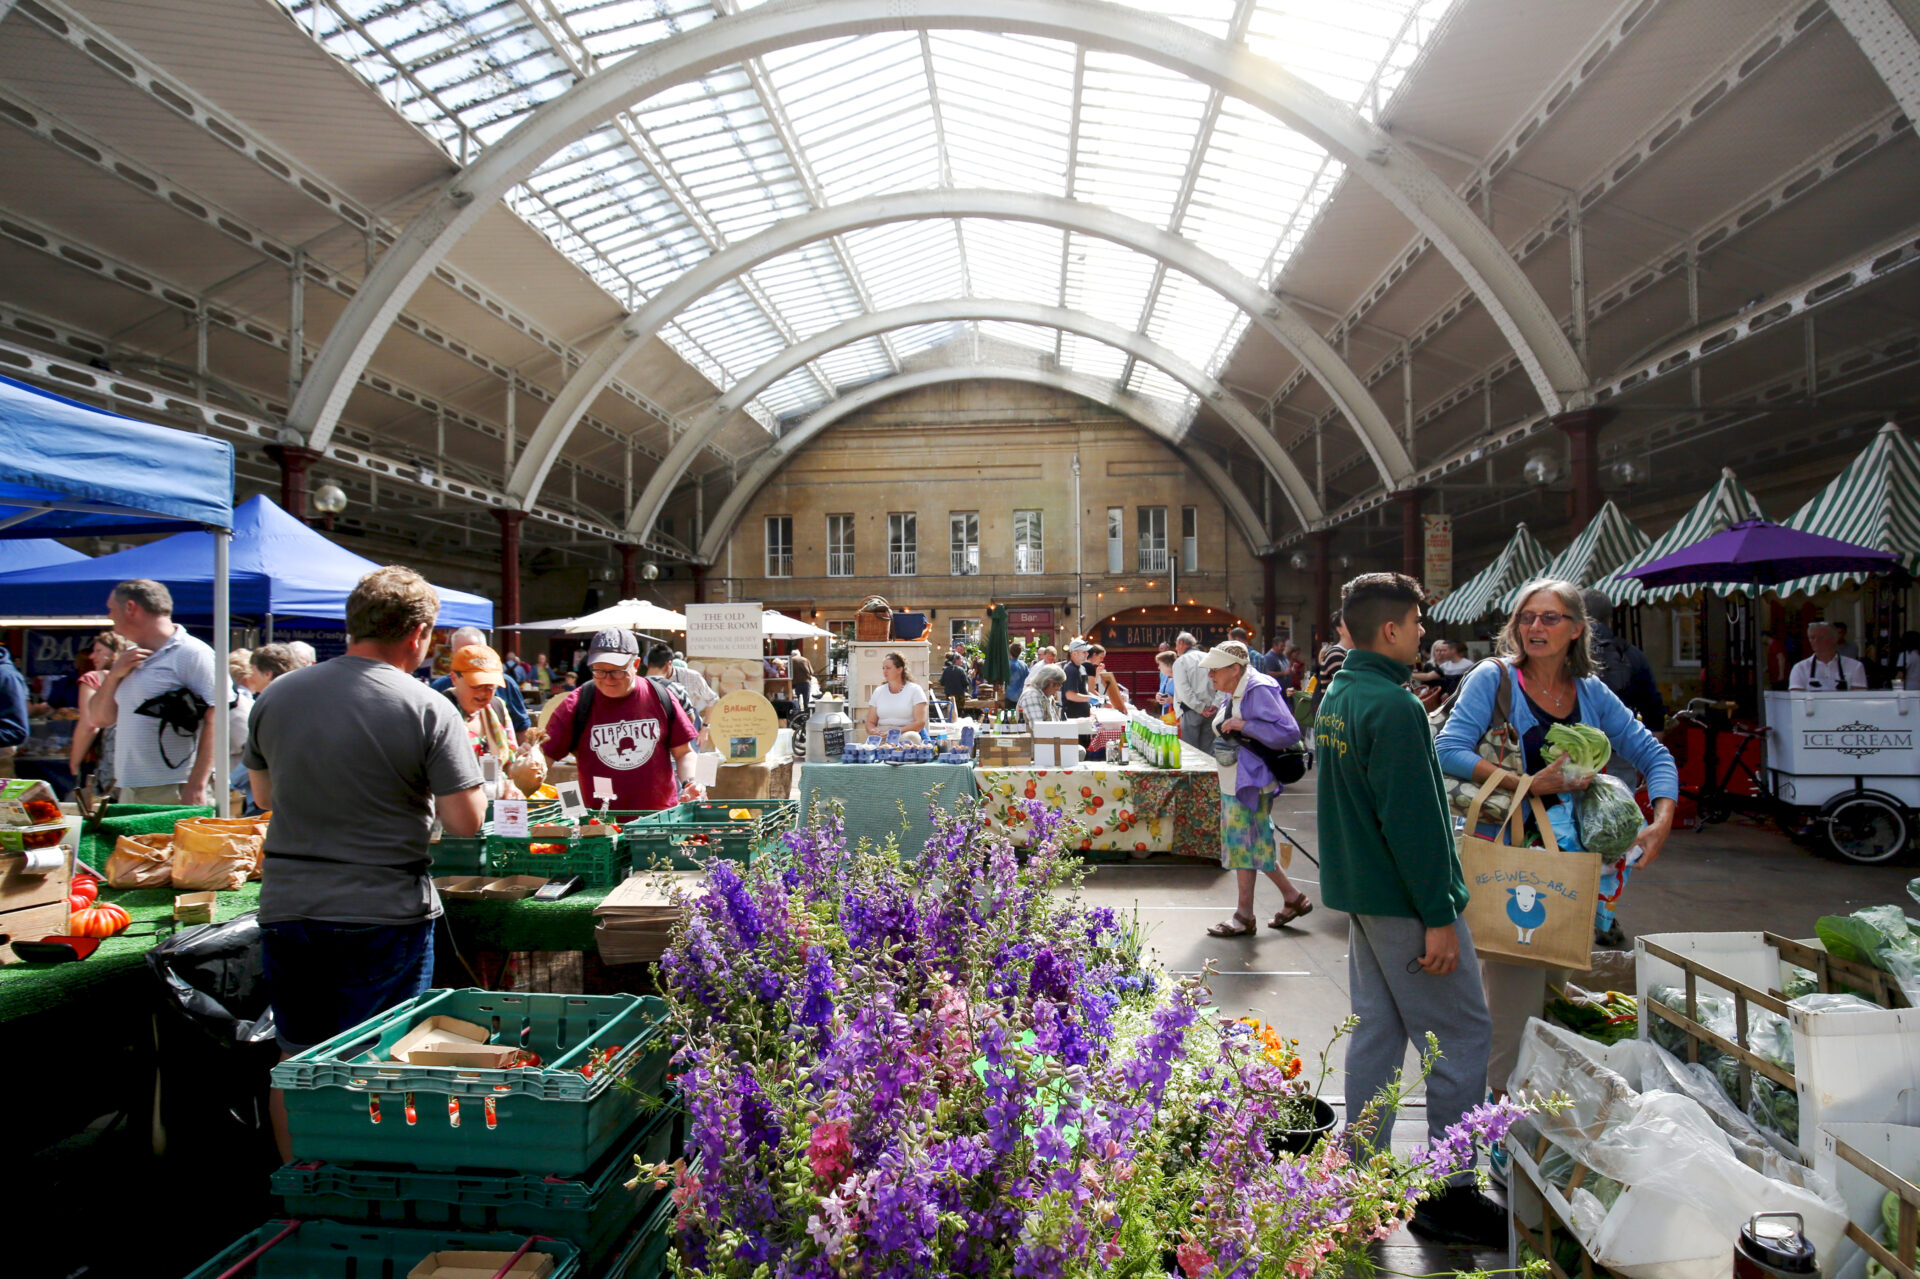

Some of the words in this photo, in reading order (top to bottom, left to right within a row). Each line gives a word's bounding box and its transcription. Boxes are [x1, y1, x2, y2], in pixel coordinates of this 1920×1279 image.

[704, 613, 722, 621] THE
[724, 612, 745, 620] OLD
[1021, 613, 1037, 622] Bar
[689, 622, 725, 631] CHEESE
[728, 622, 758, 630] ROOM
[316, 630, 345, 642] Crusty
[1127, 627, 1153, 644] BATH
[1156, 627, 1186, 644] PIZZ
[592, 722, 657, 748] SLAPSTICK
[1804, 734, 1834, 746] ICE
[1841, 734, 1912, 746] CREAM
